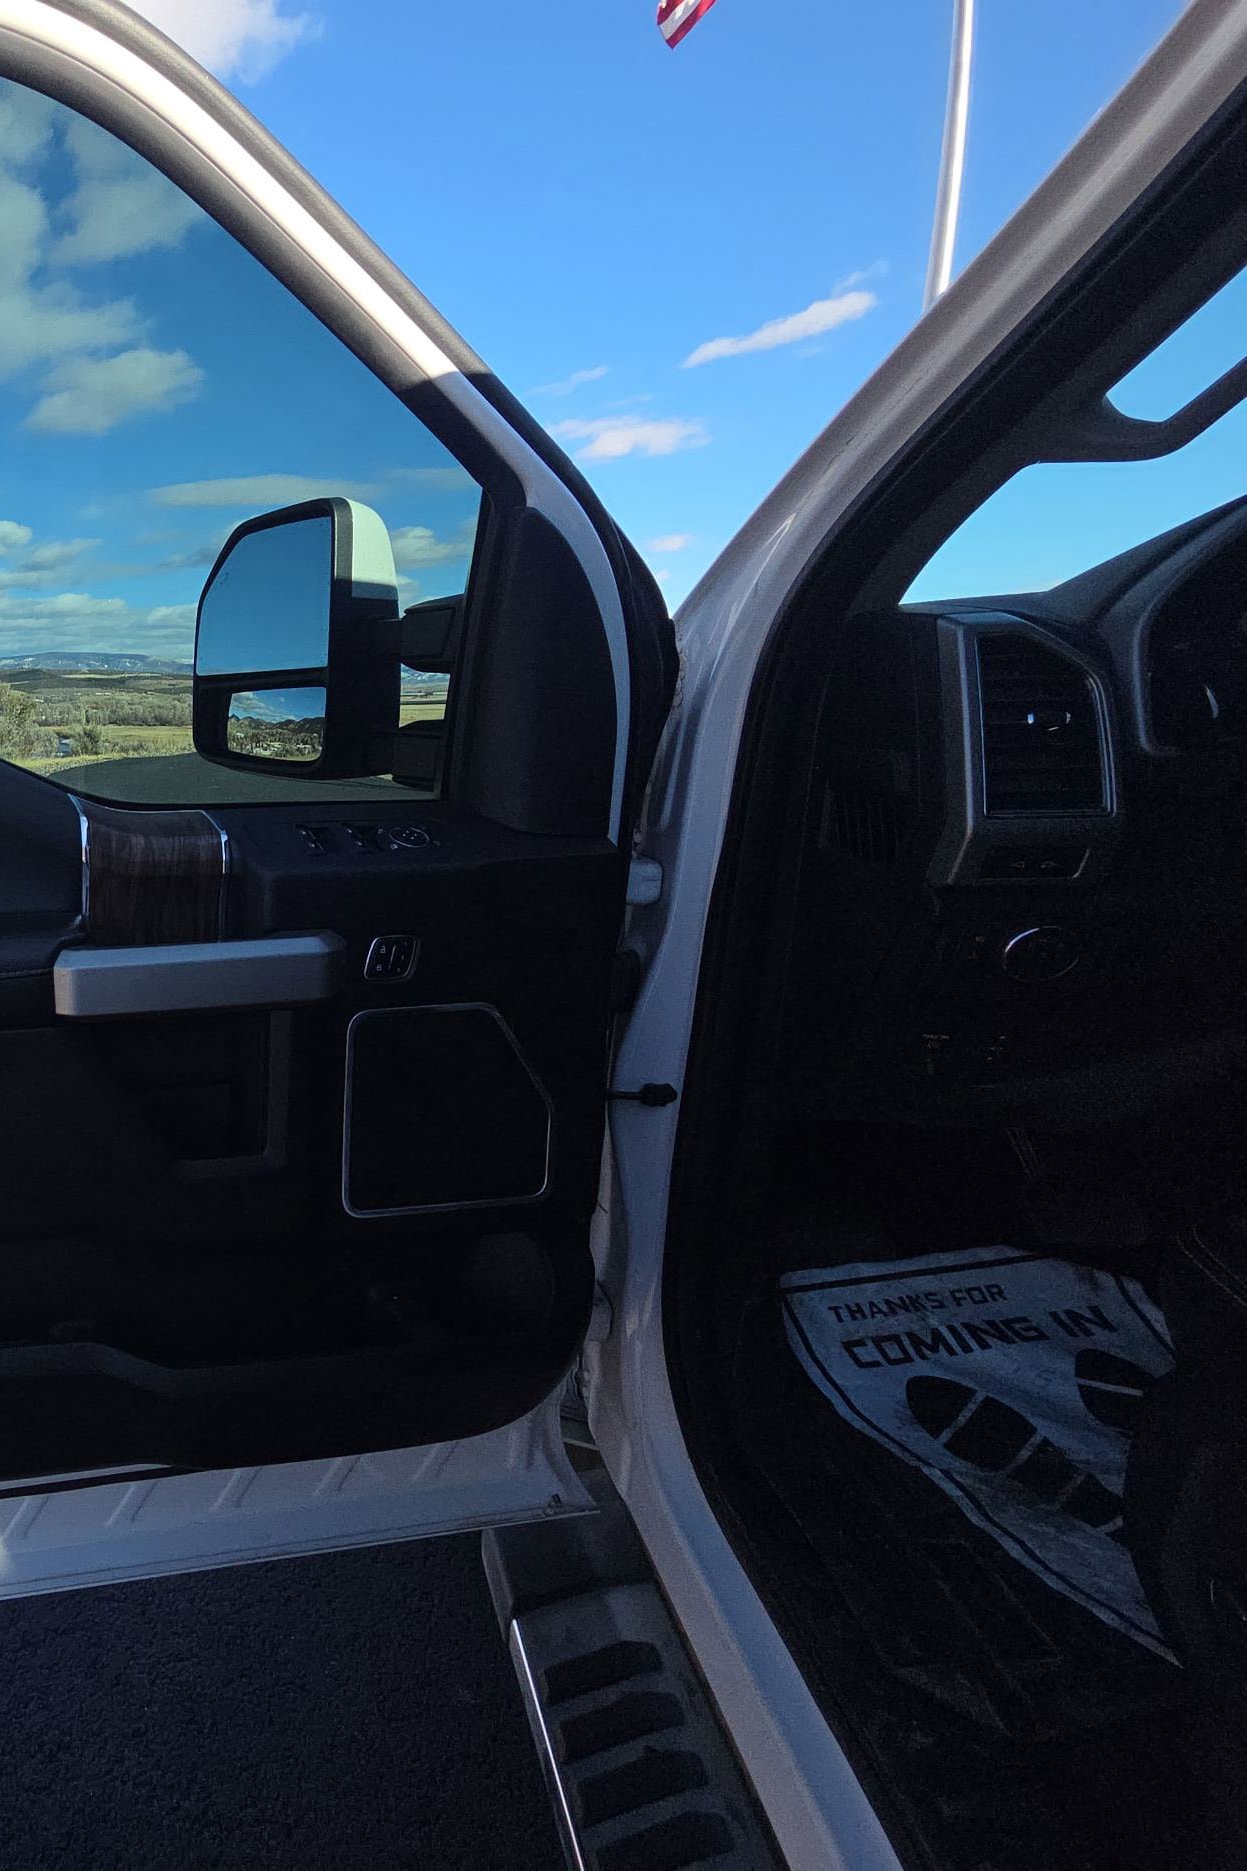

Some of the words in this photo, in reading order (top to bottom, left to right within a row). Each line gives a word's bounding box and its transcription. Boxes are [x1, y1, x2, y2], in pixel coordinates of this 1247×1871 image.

[828, 1291, 946, 1324] THANKS
[950, 1283, 1006, 1306] FOR
[841, 1316, 1050, 1369] COMING
[1048, 1304, 1119, 1339] IN
